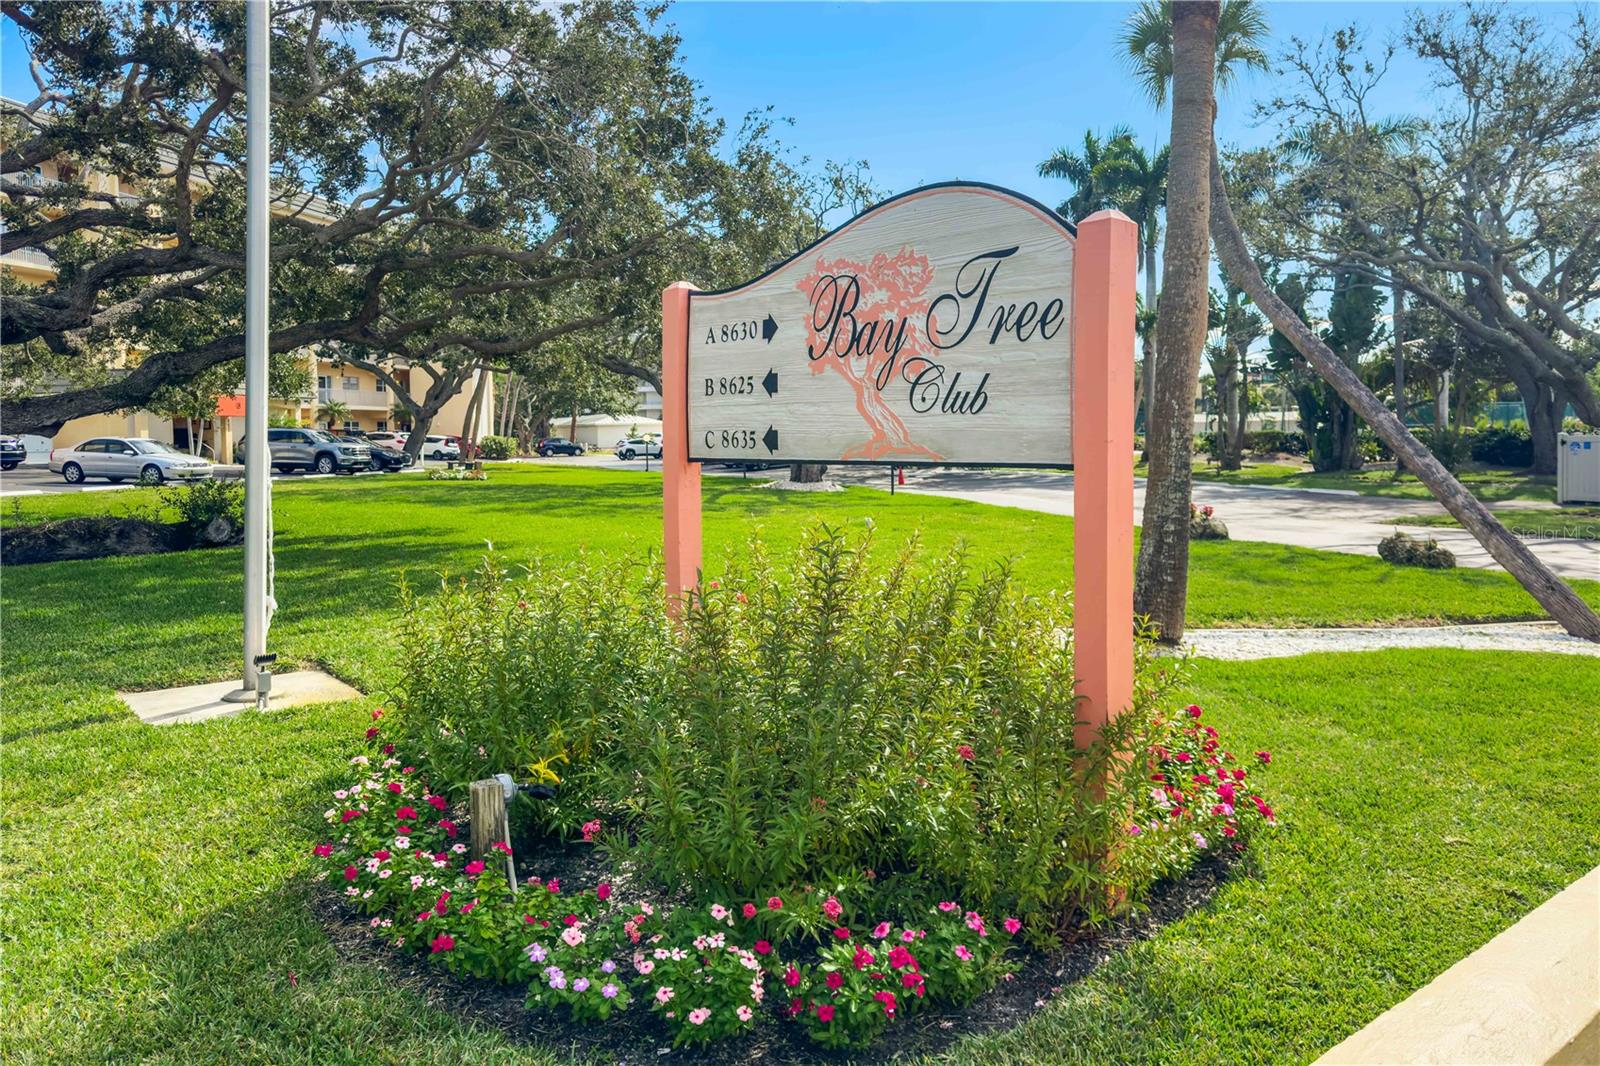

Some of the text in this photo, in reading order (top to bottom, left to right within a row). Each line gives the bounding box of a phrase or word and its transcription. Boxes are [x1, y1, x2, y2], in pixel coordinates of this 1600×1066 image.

[808, 246, 1065, 391] Bay Tree
[704, 320, 758, 345] A 8630
[704, 376, 754, 396] B 8625
[902, 357, 991, 415] Club
[704, 430, 757, 450] C 8635
